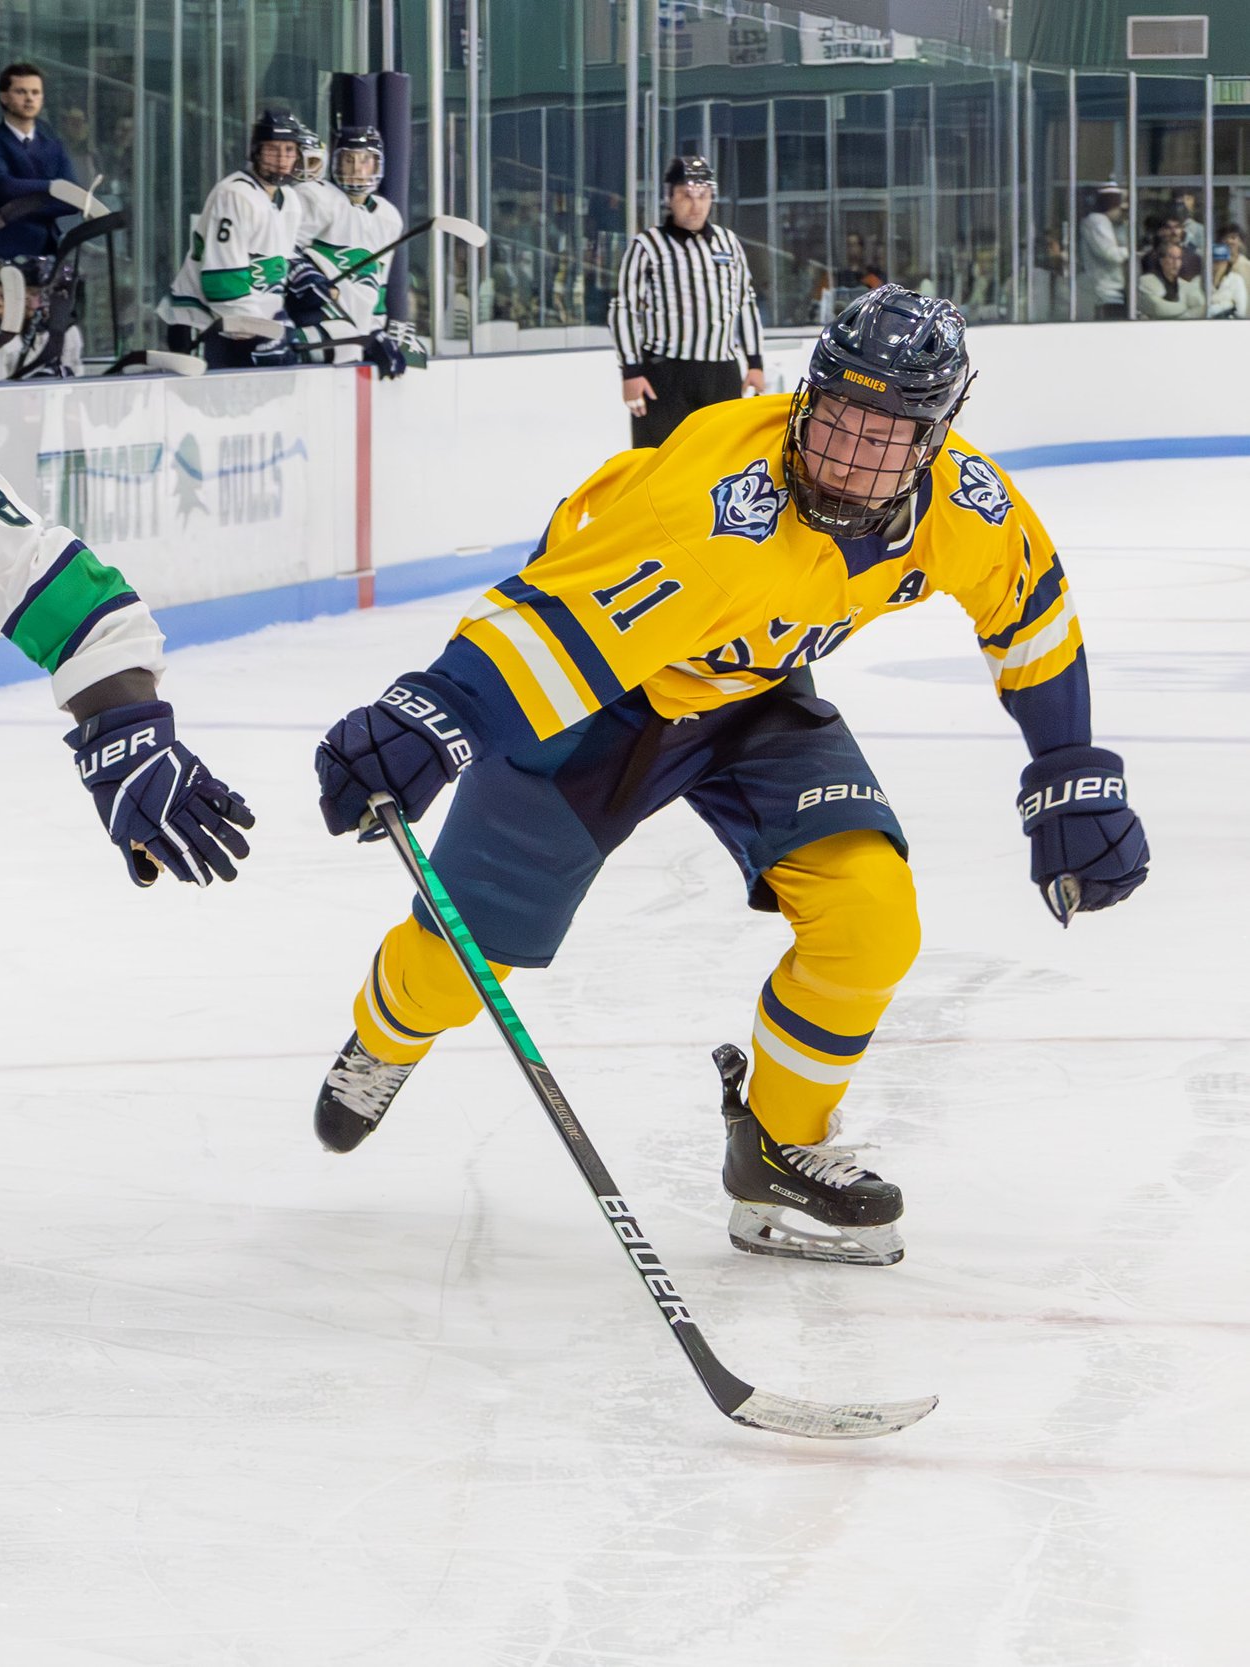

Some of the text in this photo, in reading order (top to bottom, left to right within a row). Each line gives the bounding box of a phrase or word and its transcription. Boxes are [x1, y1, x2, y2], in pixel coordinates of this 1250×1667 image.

[217, 217, 232, 243] 6
[843, 368, 887, 392] HUSKIES
[591, 559, 683, 634] 11
[77, 727, 157, 780] UER
[796, 784, 890, 812] BAUE
[598, 1195, 697, 1327] BAUER
